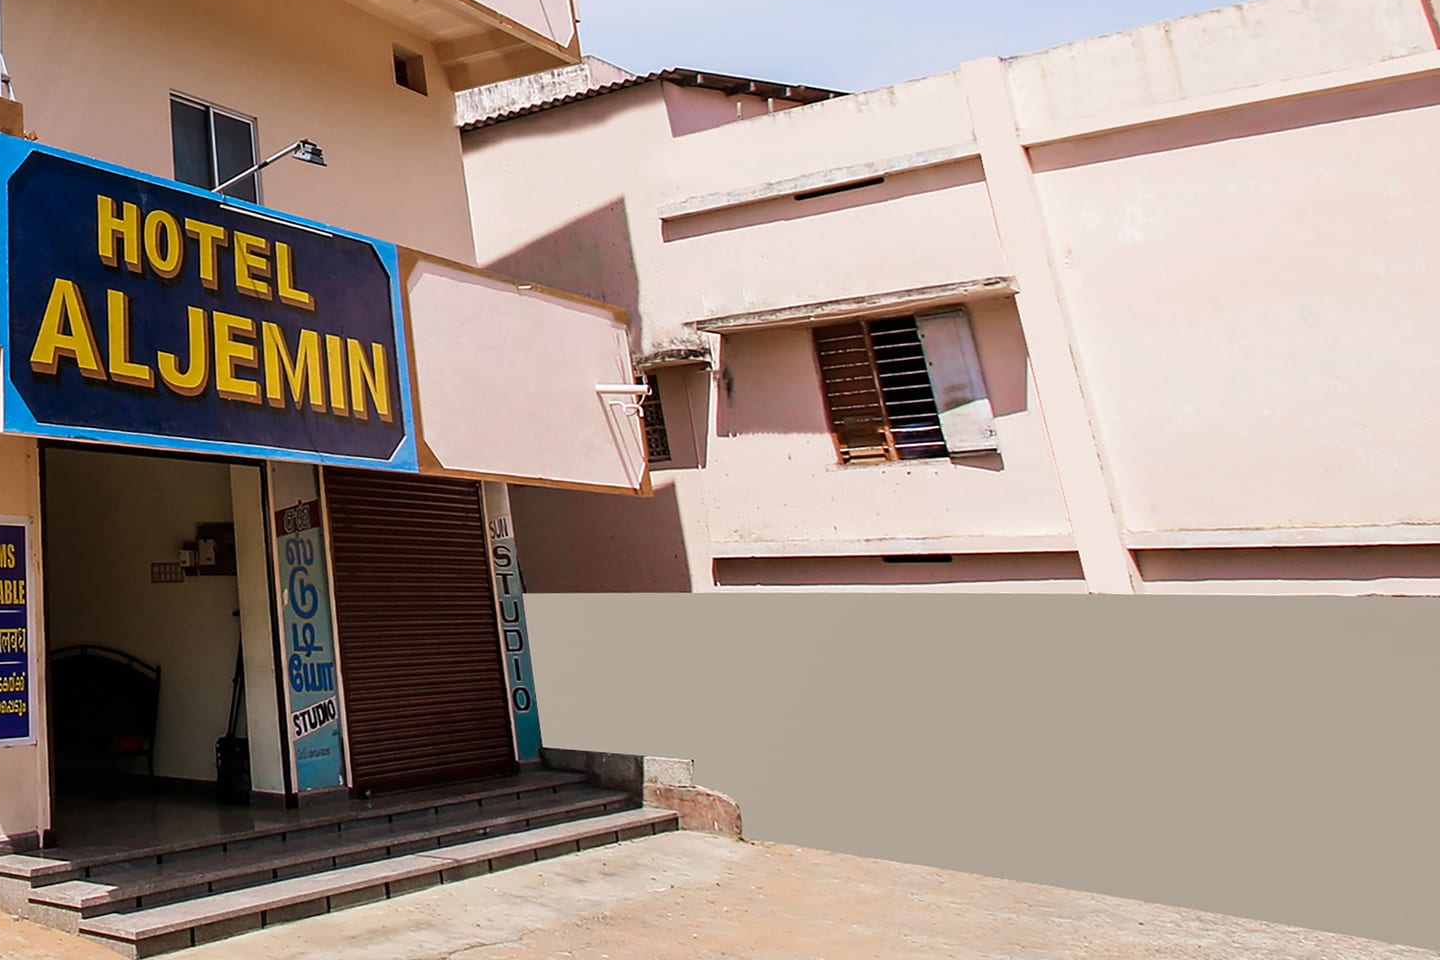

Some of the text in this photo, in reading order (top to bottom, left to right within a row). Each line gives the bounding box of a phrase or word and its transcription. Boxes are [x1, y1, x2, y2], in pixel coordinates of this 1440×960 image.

[97, 194, 315, 310] HOTEL
[29, 277, 392, 423] ALJEMIN
[489, 516, 509, 540] SUN
[492, 544, 531, 713] STUDIO
[293, 699, 336, 737] STUDIO
